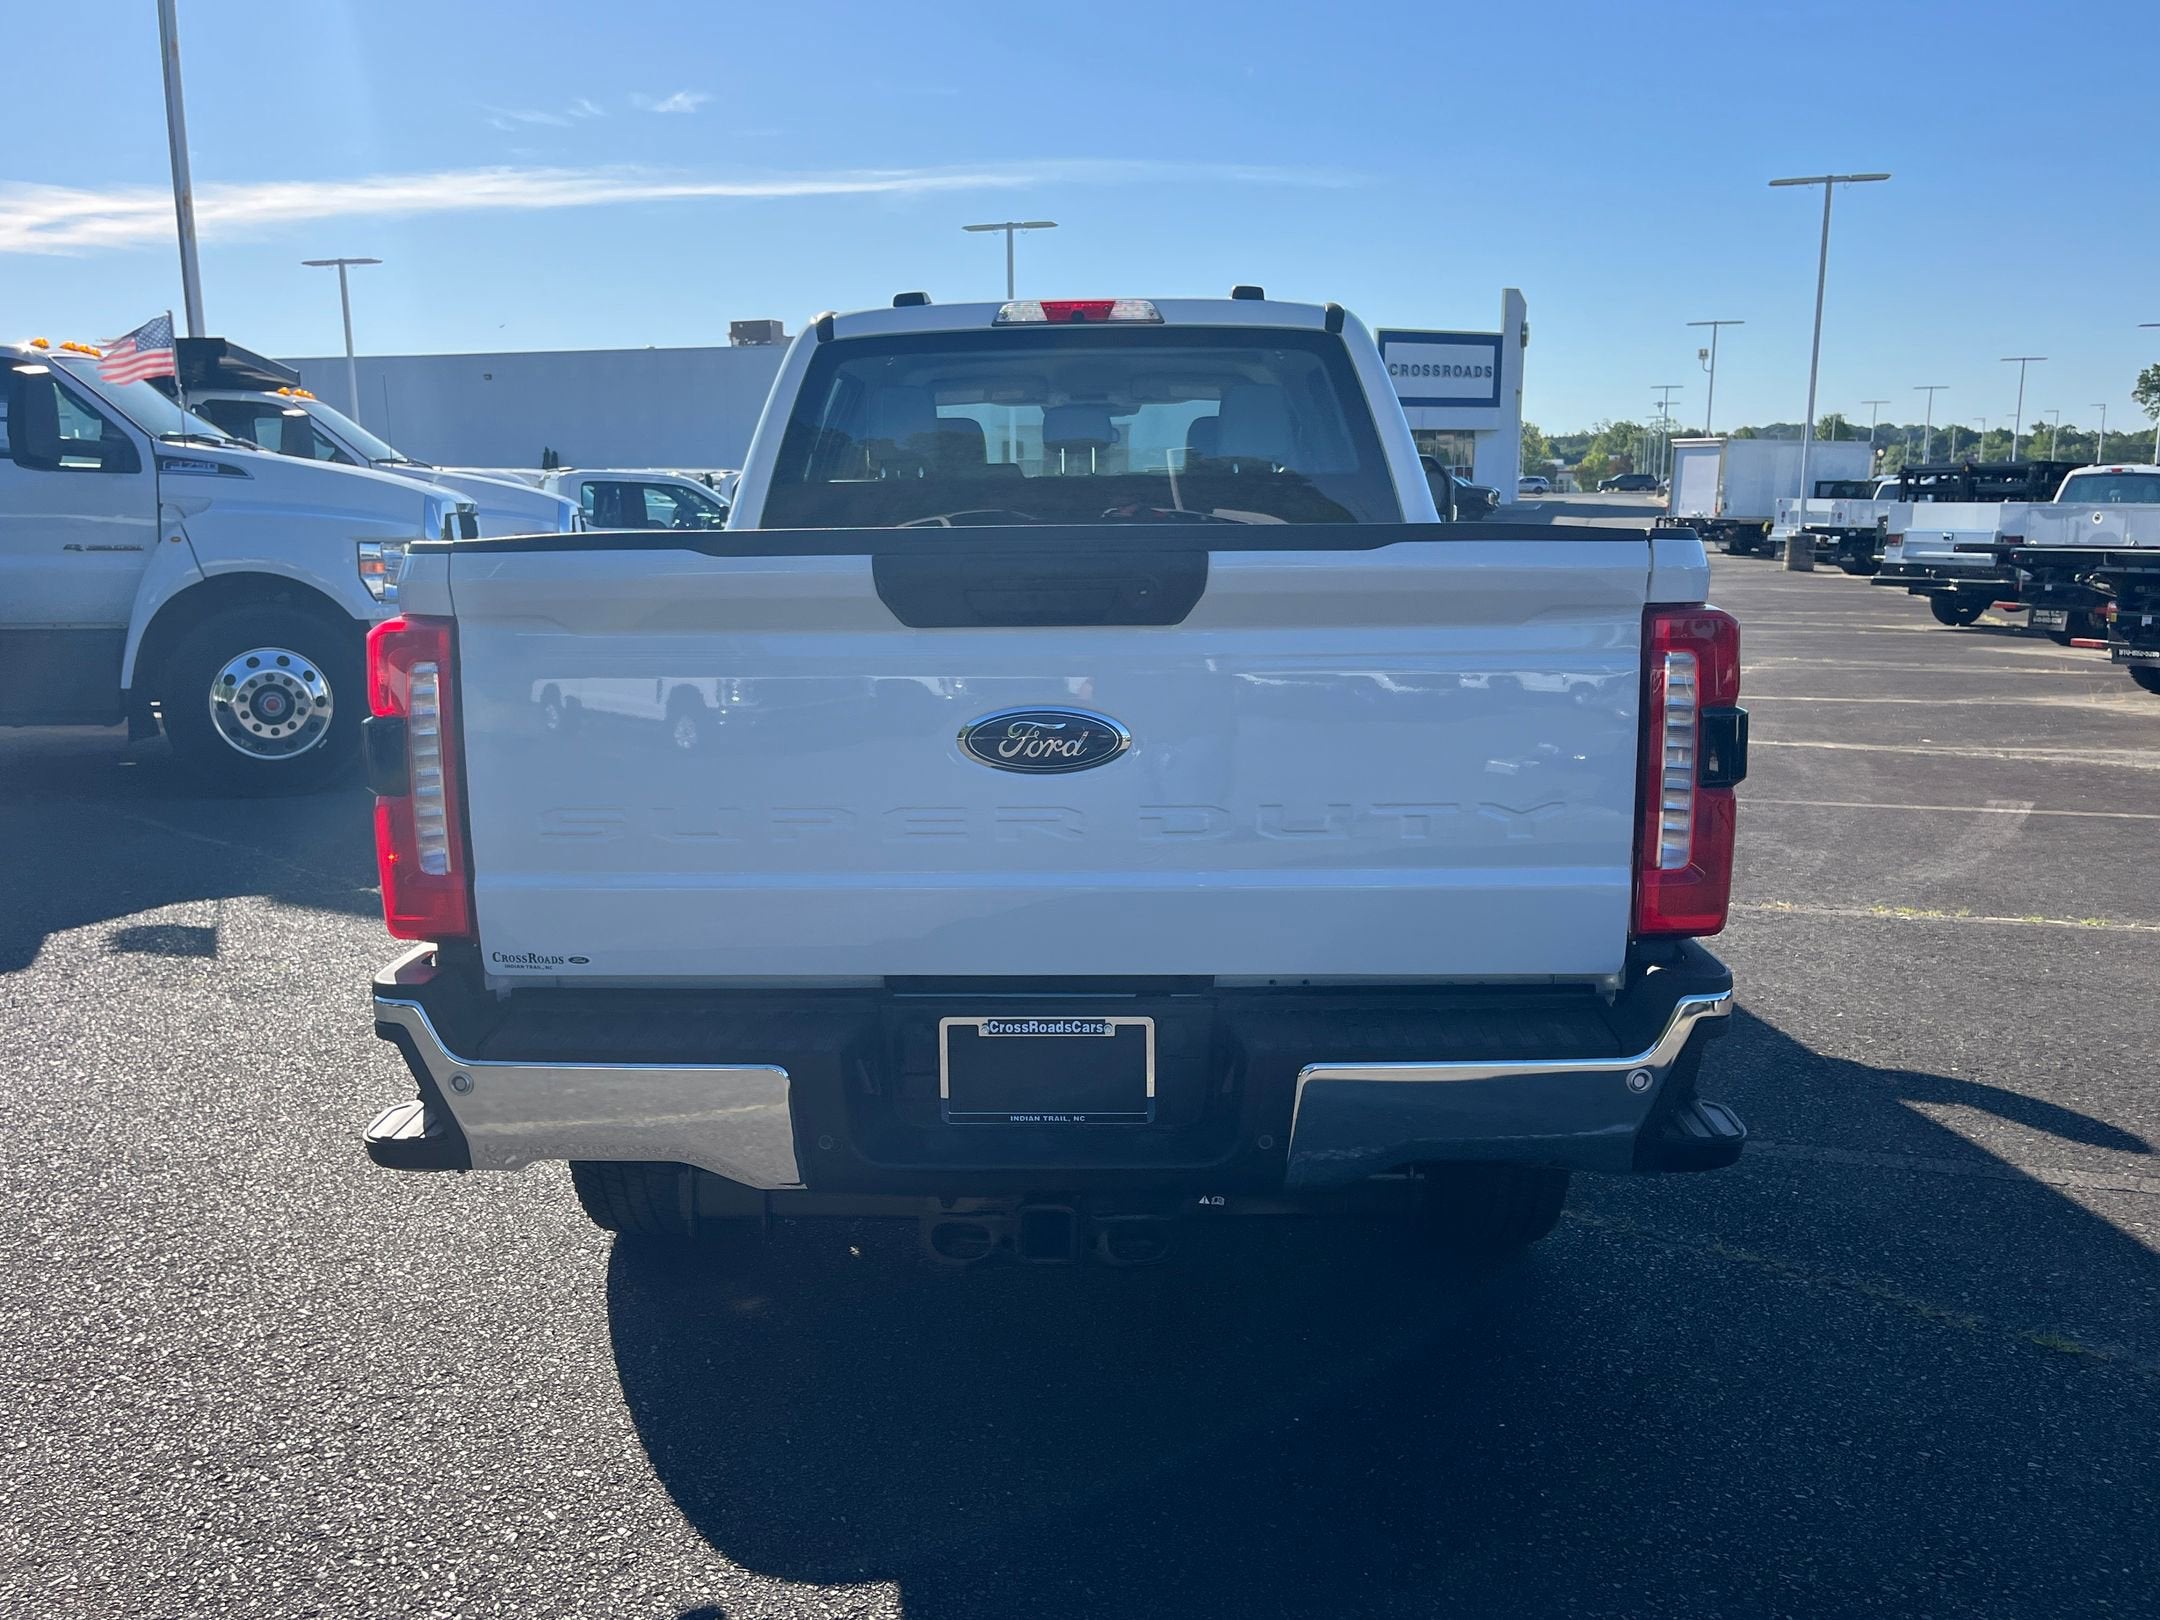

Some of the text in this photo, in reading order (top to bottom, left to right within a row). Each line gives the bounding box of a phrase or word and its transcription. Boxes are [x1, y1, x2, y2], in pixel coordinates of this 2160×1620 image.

[1388, 363, 1493, 378] CROSSROADS
[998, 721, 1090, 758] Ford
[539, 801, 1567, 843] SUPER DUTY
[989, 1020, 1104, 1034] CrossRoadsCars
